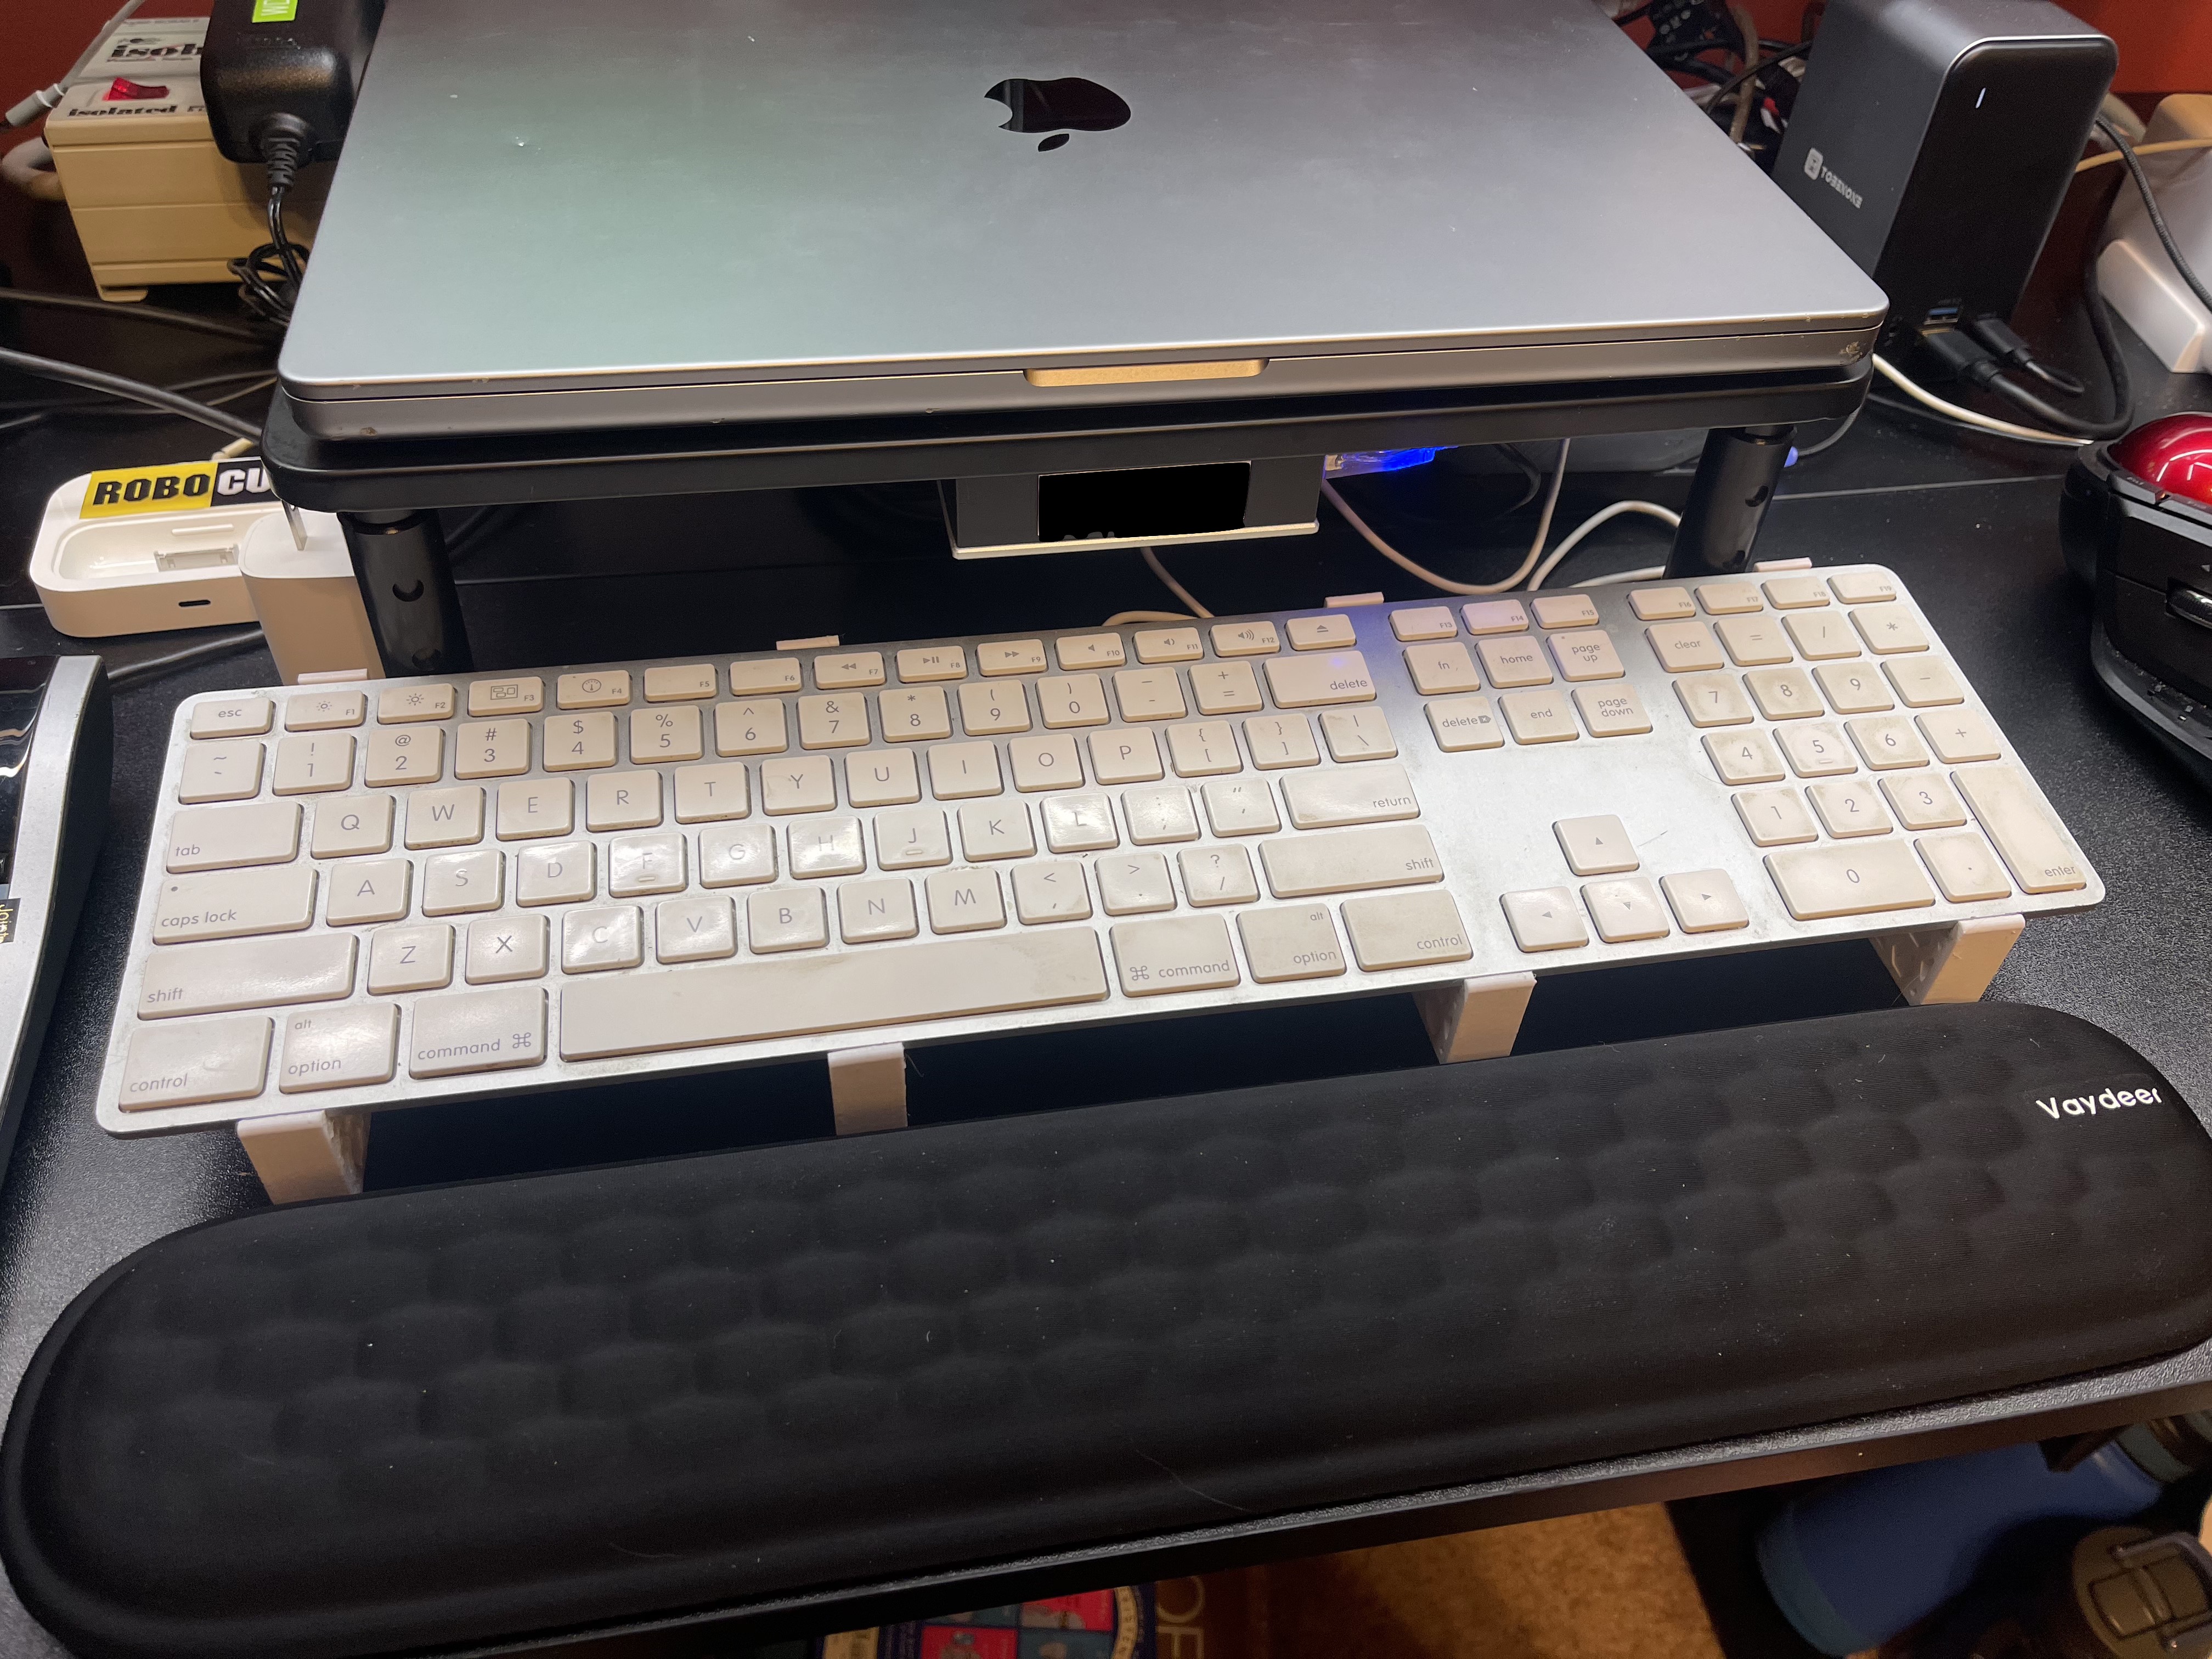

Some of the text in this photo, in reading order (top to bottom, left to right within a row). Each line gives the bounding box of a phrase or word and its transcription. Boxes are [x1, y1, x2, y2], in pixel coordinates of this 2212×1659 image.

[1571, 643, 1600, 655] page
[1674, 639, 1701, 650] clear
[1500, 653, 1533, 664] home
[1583, 653, 1598, 663] up
[1438, 661, 1450, 670] fn
[1217, 671, 1229, 679] +
[1067, 682, 1072, 694] )
[1330, 678, 1367, 690] delete
[1780, 684, 1793, 697] 8
[1849, 678, 1862, 691] 9
[990, 689, 995, 701] (
[1708, 691, 1719, 703] 7
[826, 701, 839, 713] &
[1069, 701, 1080, 714] 0
[1598, 697, 1628, 709] page
[218, 708, 242, 718] esc
[990, 708, 1001, 721] 9
[1531, 708, 1553, 719] end
[1601, 706, 1634, 718] down
[573, 720, 584, 734] $
[656, 714, 673, 728] %
[828, 720, 839, 733] 7
[910, 713, 921, 727] 8
[1442, 715, 1479, 728] delete
[485, 728, 497, 741] #
[744, 727, 756, 741] 6
[1198, 728, 1206, 742] {
[1274, 721, 1283, 735] }
[1955, 728, 1967, 738] +
[395, 735, 411, 747] @
[659, 733, 670, 748] 5
[1813, 740, 1825, 754] 5
[1884, 733, 1897, 747] 6
[311, 743, 315, 756] !
[572, 741, 584, 755] 4
[1119, 745, 1132, 760] P
[1205, 748, 1212, 762] [
[1282, 742, 1289, 755] ]
[1741, 746, 1753, 760] 4
[484, 748, 495, 763] 3
[1038, 752, 1054, 766] O
[307, 763, 313, 777] 1
[396, 756, 408, 770] 2
[874, 766, 889, 782] U
[791, 774, 804, 789] Y
[704, 781, 716, 797] T
[616, 789, 629, 805] R
[1373, 795, 1411, 809] return
[1919, 791, 1933, 806] 3
[528, 796, 539, 813] E
[1844, 798, 1860, 813] 2
[432, 804, 455, 821] W
[1074, 811, 1087, 826] L
[1770, 805, 1782, 821] 1
[341, 814, 360, 831] Q
[989, 820, 1005, 836] K
[908, 827, 917, 844] J
[176, 845, 200, 856] tab
[817, 835, 834, 852] H
[729, 844, 744, 860] G
[642, 852, 652, 869] F
[1210, 854, 1220, 868] ?
[1405, 858, 1434, 871] shift
[549, 861, 563, 878] D
[1127, 865, 1140, 874] >
[1846, 868, 1860, 884] 0
[2044, 864, 2076, 879] enter
[455, 869, 469, 887] S
[1043, 872, 1056, 883] <
[357, 879, 375, 896] A
[955, 888, 977, 906] M
[868, 898, 885, 915] N
[161, 909, 237, 928] caps lock
[779, 907, 792, 924] B
[1310, 912, 1324, 921] alt
[686, 916, 703, 933] V
[592, 926, 607, 944] C
[495, 935, 512, 953] X
[1417, 935, 1463, 950] control
[400, 946, 416, 964] Z
[1293, 950, 1336, 966] option
[1159, 960, 1230, 978] command
[147, 988, 183, 1003] shift
[295, 1019, 312, 1030] alt
[418, 1039, 500, 1060] command
[288, 1059, 341, 1077] option
[129, 1073, 188, 1093] control
[2035, 1088, 2162, 1119] Vaydeer
